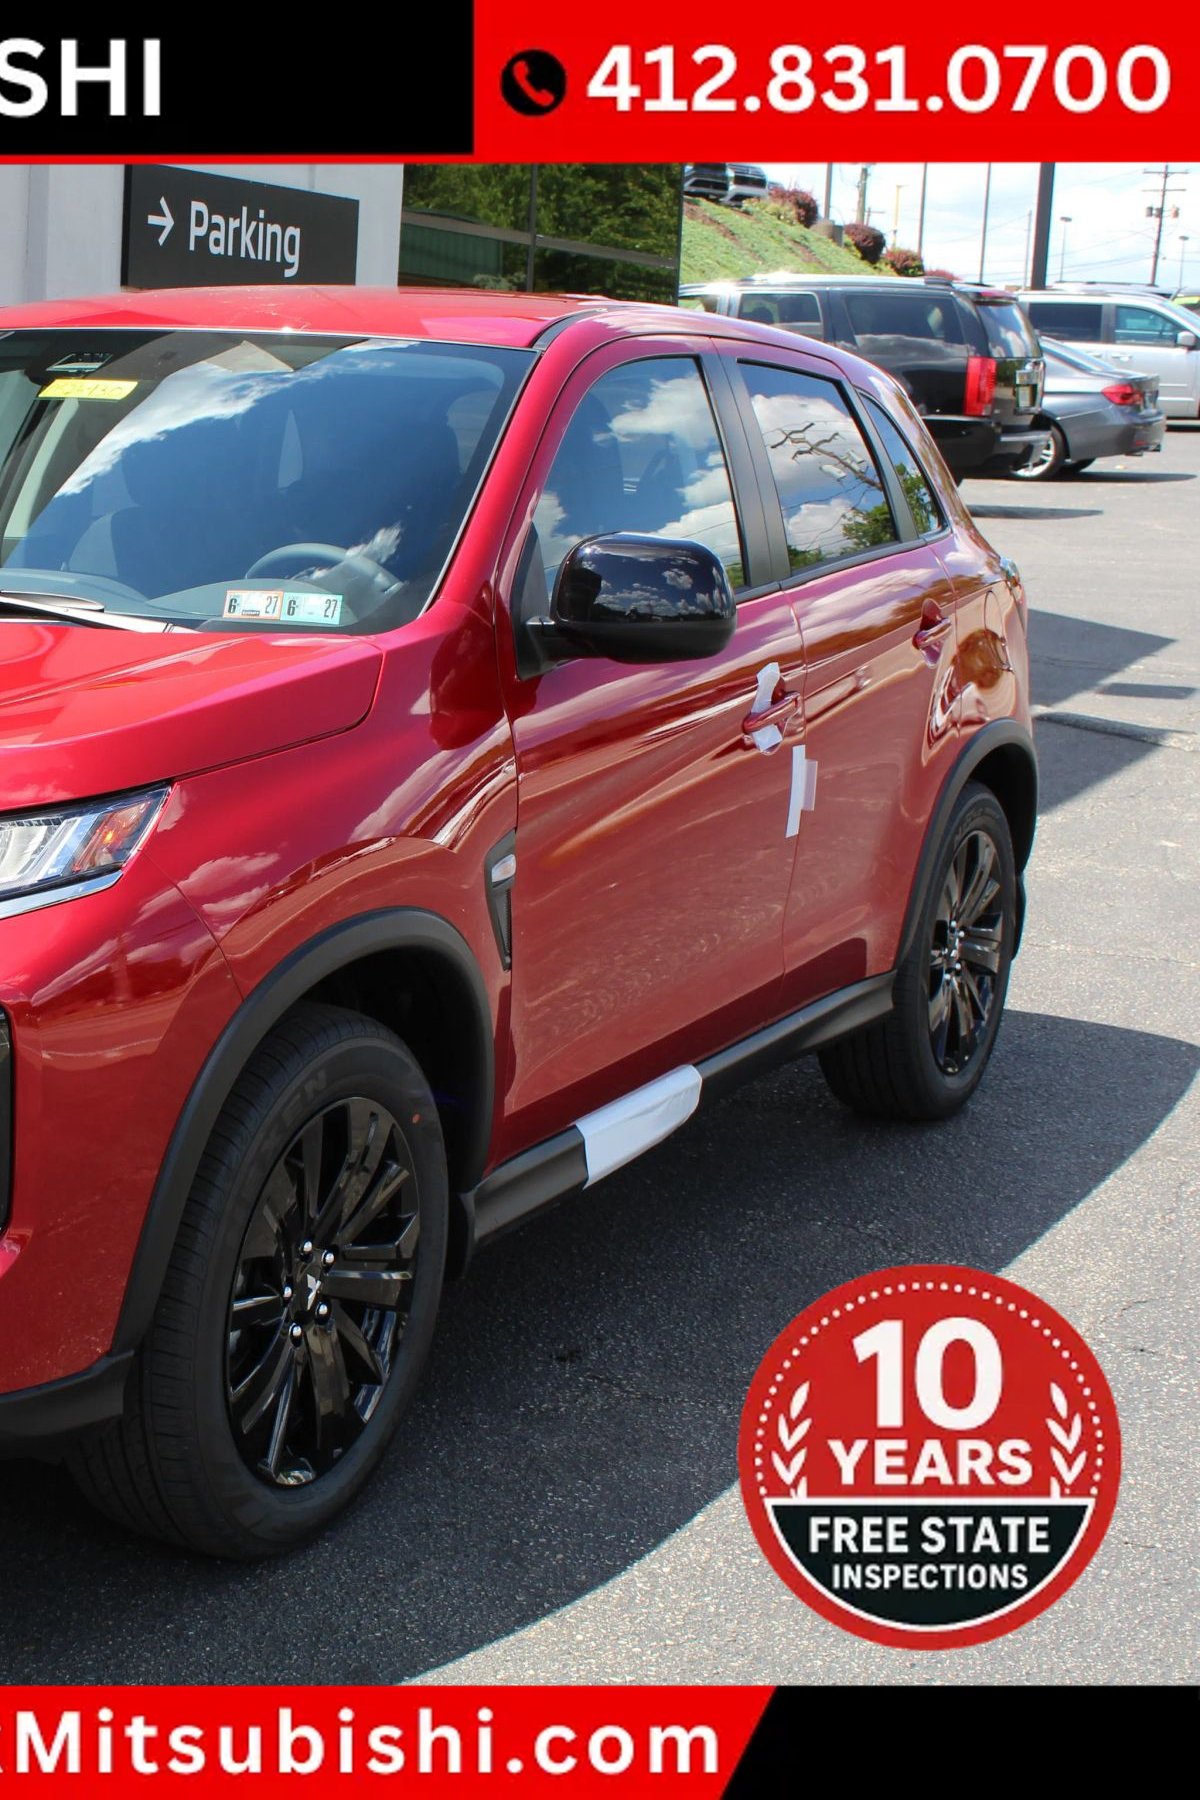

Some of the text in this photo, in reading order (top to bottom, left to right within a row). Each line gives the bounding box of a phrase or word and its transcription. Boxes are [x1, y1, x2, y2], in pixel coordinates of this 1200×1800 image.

[189, 200, 301, 278] Parking
[228, 598, 237, 614] 6
[265, 596, 279, 614] 27
[287, 599, 338, 619] 6 27
